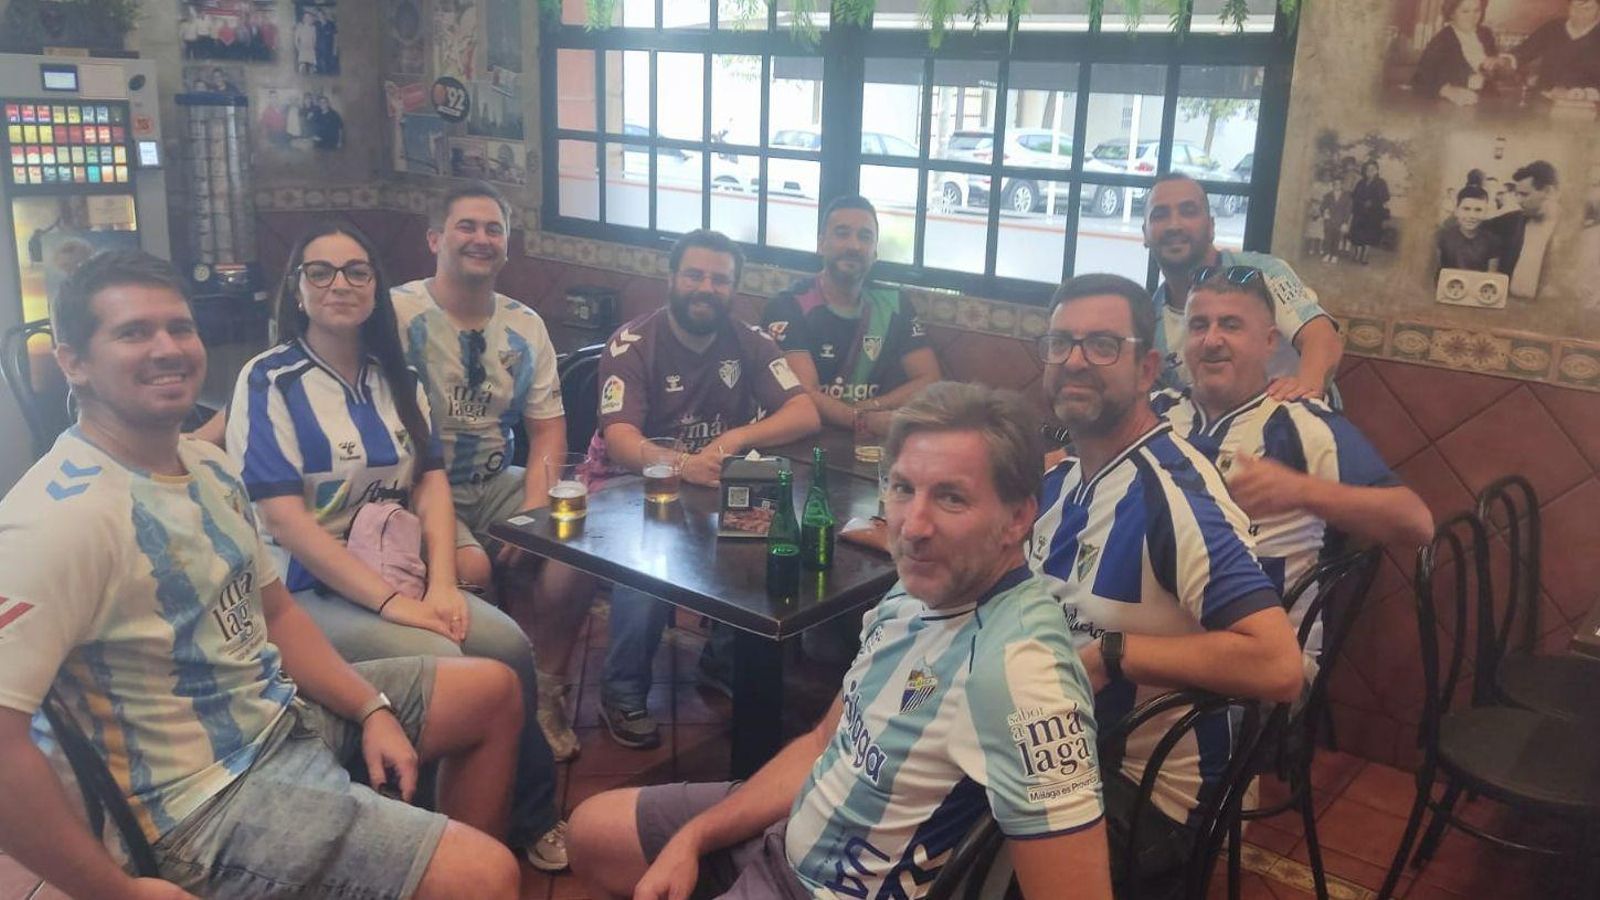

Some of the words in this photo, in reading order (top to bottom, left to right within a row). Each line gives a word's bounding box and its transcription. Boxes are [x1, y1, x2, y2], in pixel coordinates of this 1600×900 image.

[844, 680, 886, 782] álaga
[1026, 702, 1085, 747] má
[1018, 736, 1090, 776] laga
